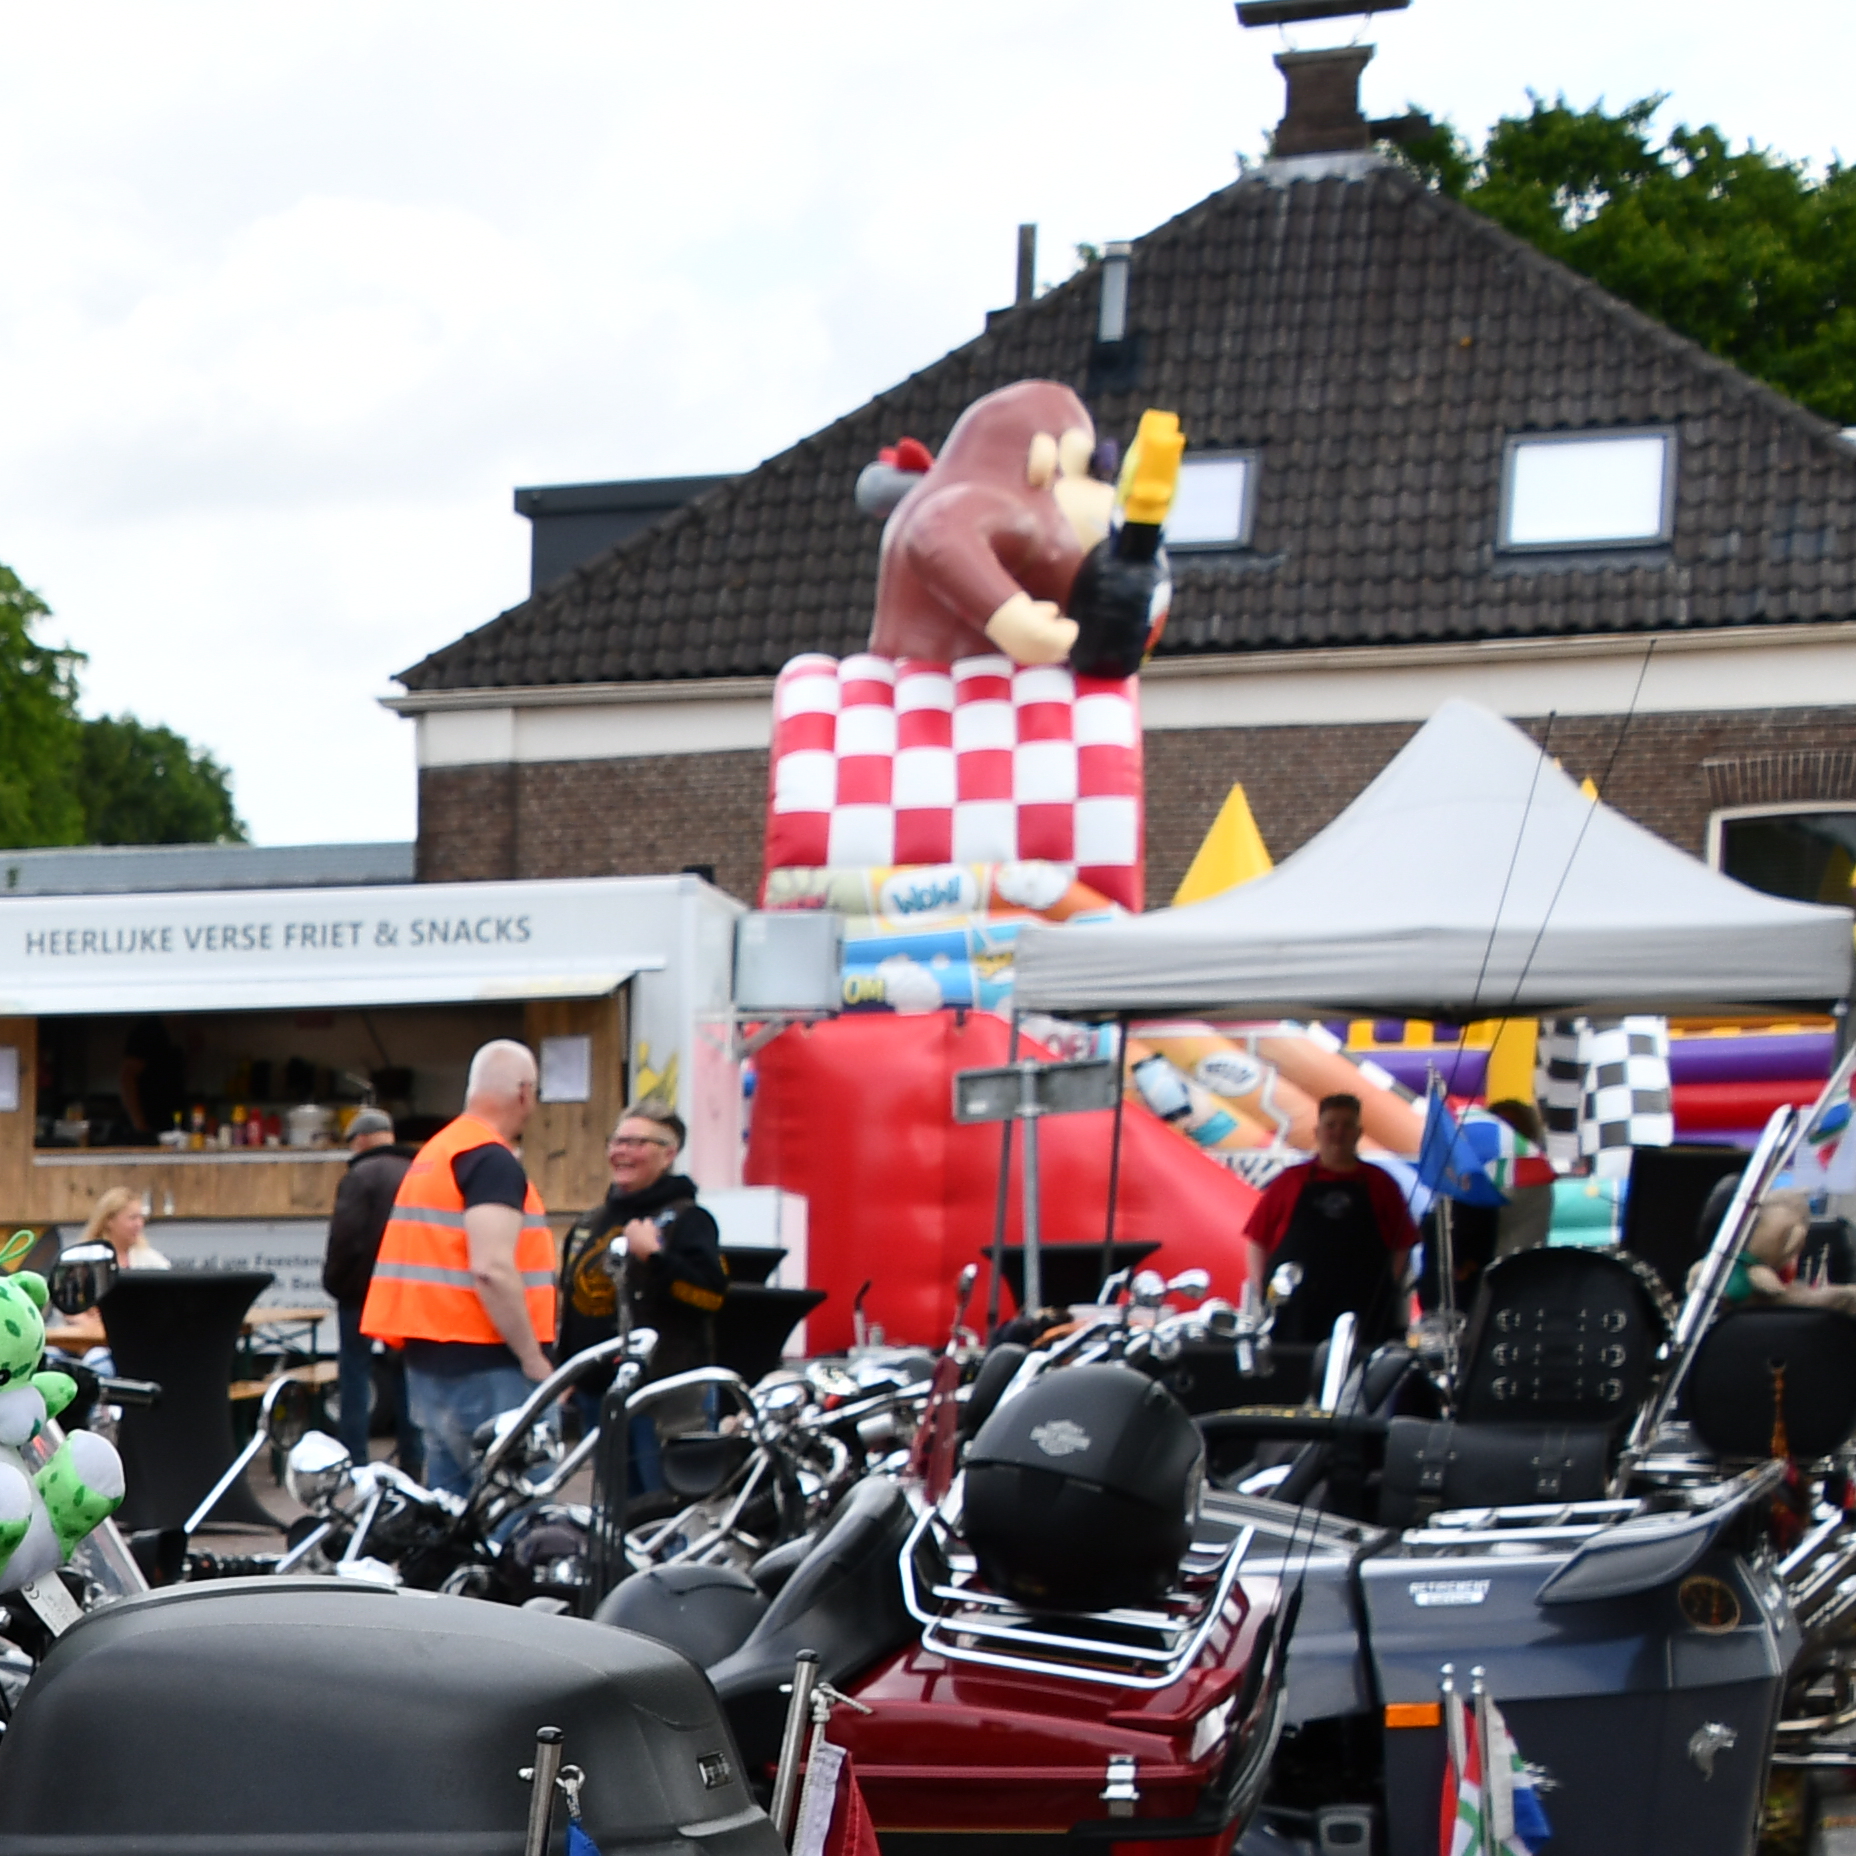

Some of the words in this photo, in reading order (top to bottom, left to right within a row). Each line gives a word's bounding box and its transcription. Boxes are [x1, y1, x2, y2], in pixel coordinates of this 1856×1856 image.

[25, 925, 174, 956] HEERLIJKE
[183, 923, 274, 952] VERSE
[284, 919, 364, 949] FRIET
[373, 919, 399, 947] &
[408, 914, 534, 946] SNACKS
